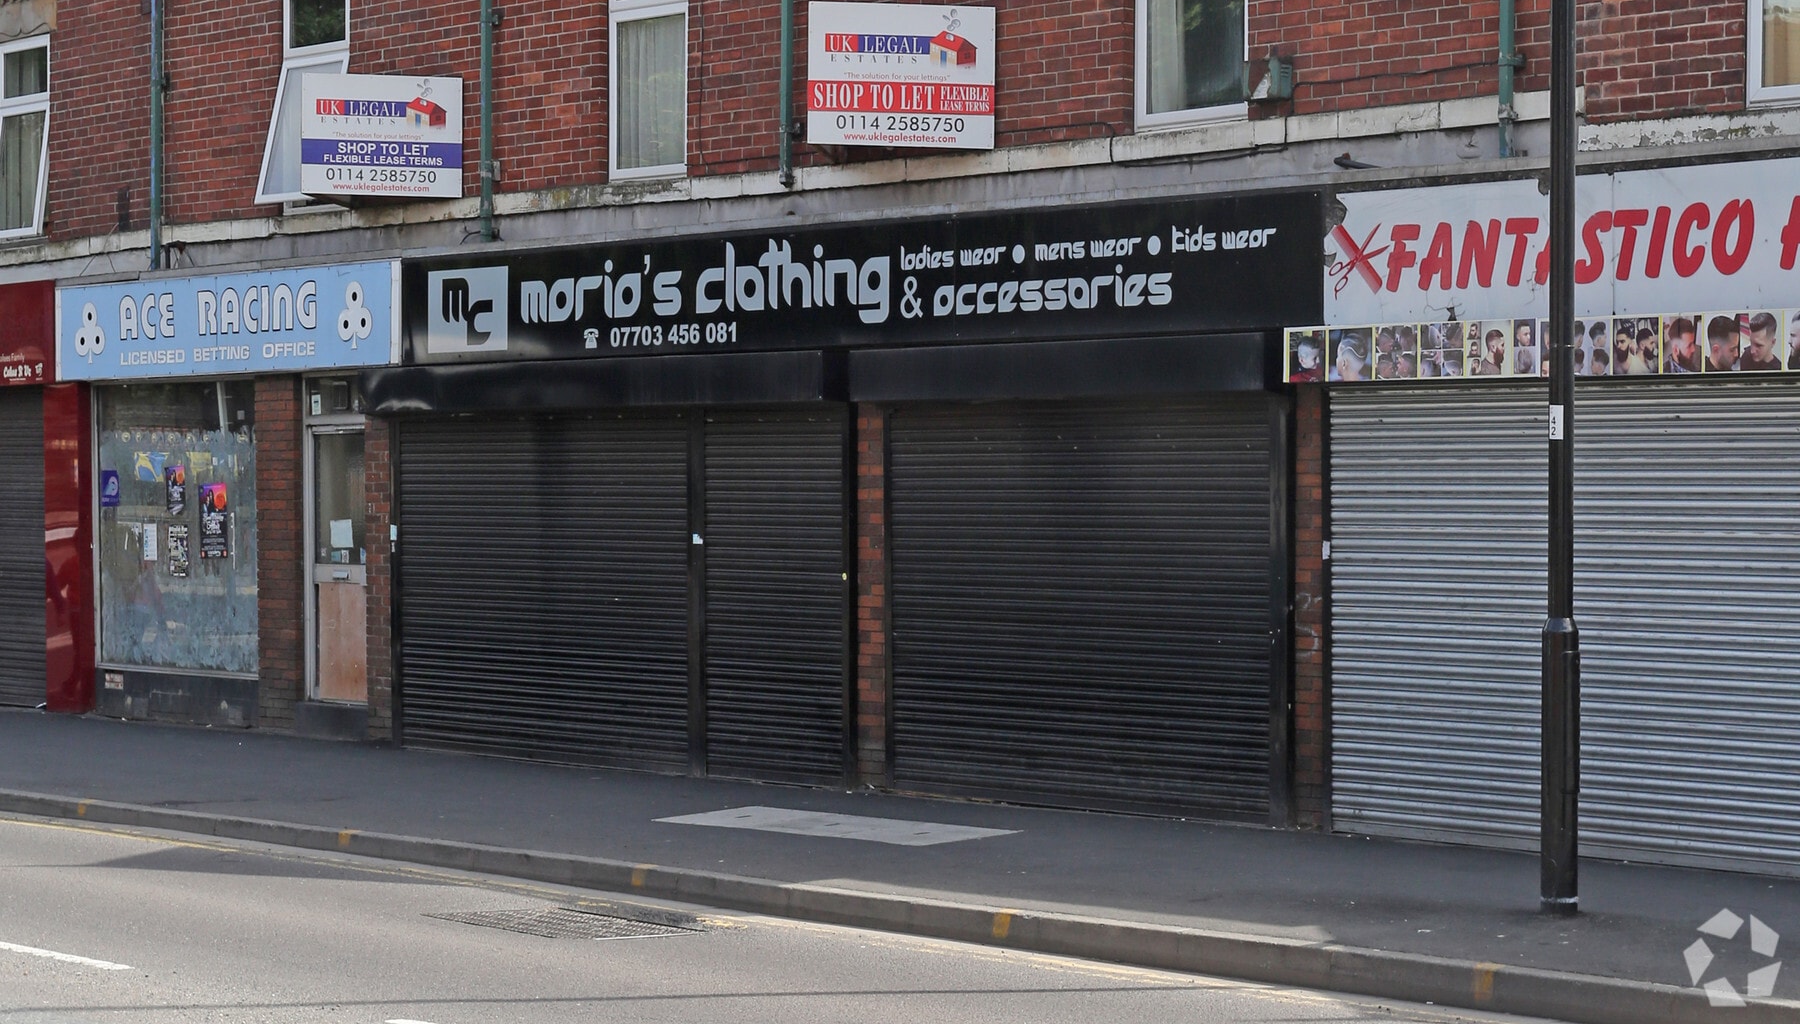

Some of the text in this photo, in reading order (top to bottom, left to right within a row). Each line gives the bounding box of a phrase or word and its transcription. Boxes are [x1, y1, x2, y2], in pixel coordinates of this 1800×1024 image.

[829, 35, 922, 54] UK LEGAL
[830, 54, 918, 64] ESTATES
[861, 72, 890, 80] solution
[813, 82, 934, 110] SHOP TO LET
[940, 86, 989, 101] FLEXIBLE
[320, 100, 400, 117] UK LEGAL
[940, 101, 989, 112] LEASE TERMS
[321, 116, 396, 125] ESTATES
[836, 115, 964, 132] 0114 2585750
[844, 133, 956, 143] www.uklegalestates.com
[337, 142, 429, 156] SHOP TO LET
[323, 154, 443, 166] FLEXIBLE LEASE TERMS
[326, 168, 436, 183] 0114 2585750
[333, 183, 430, 193] www.uklegalestates.com
[900, 224, 1277, 271] ladies wear mens wear kids wear
[696, 238, 891, 324] clothing
[899, 263, 1173, 319] & accessories
[119, 280, 317, 341] ACE RACING
[610, 321, 738, 347] 07703 456 081
[120, 341, 316, 366] LICENSED BETTING OFFICE
